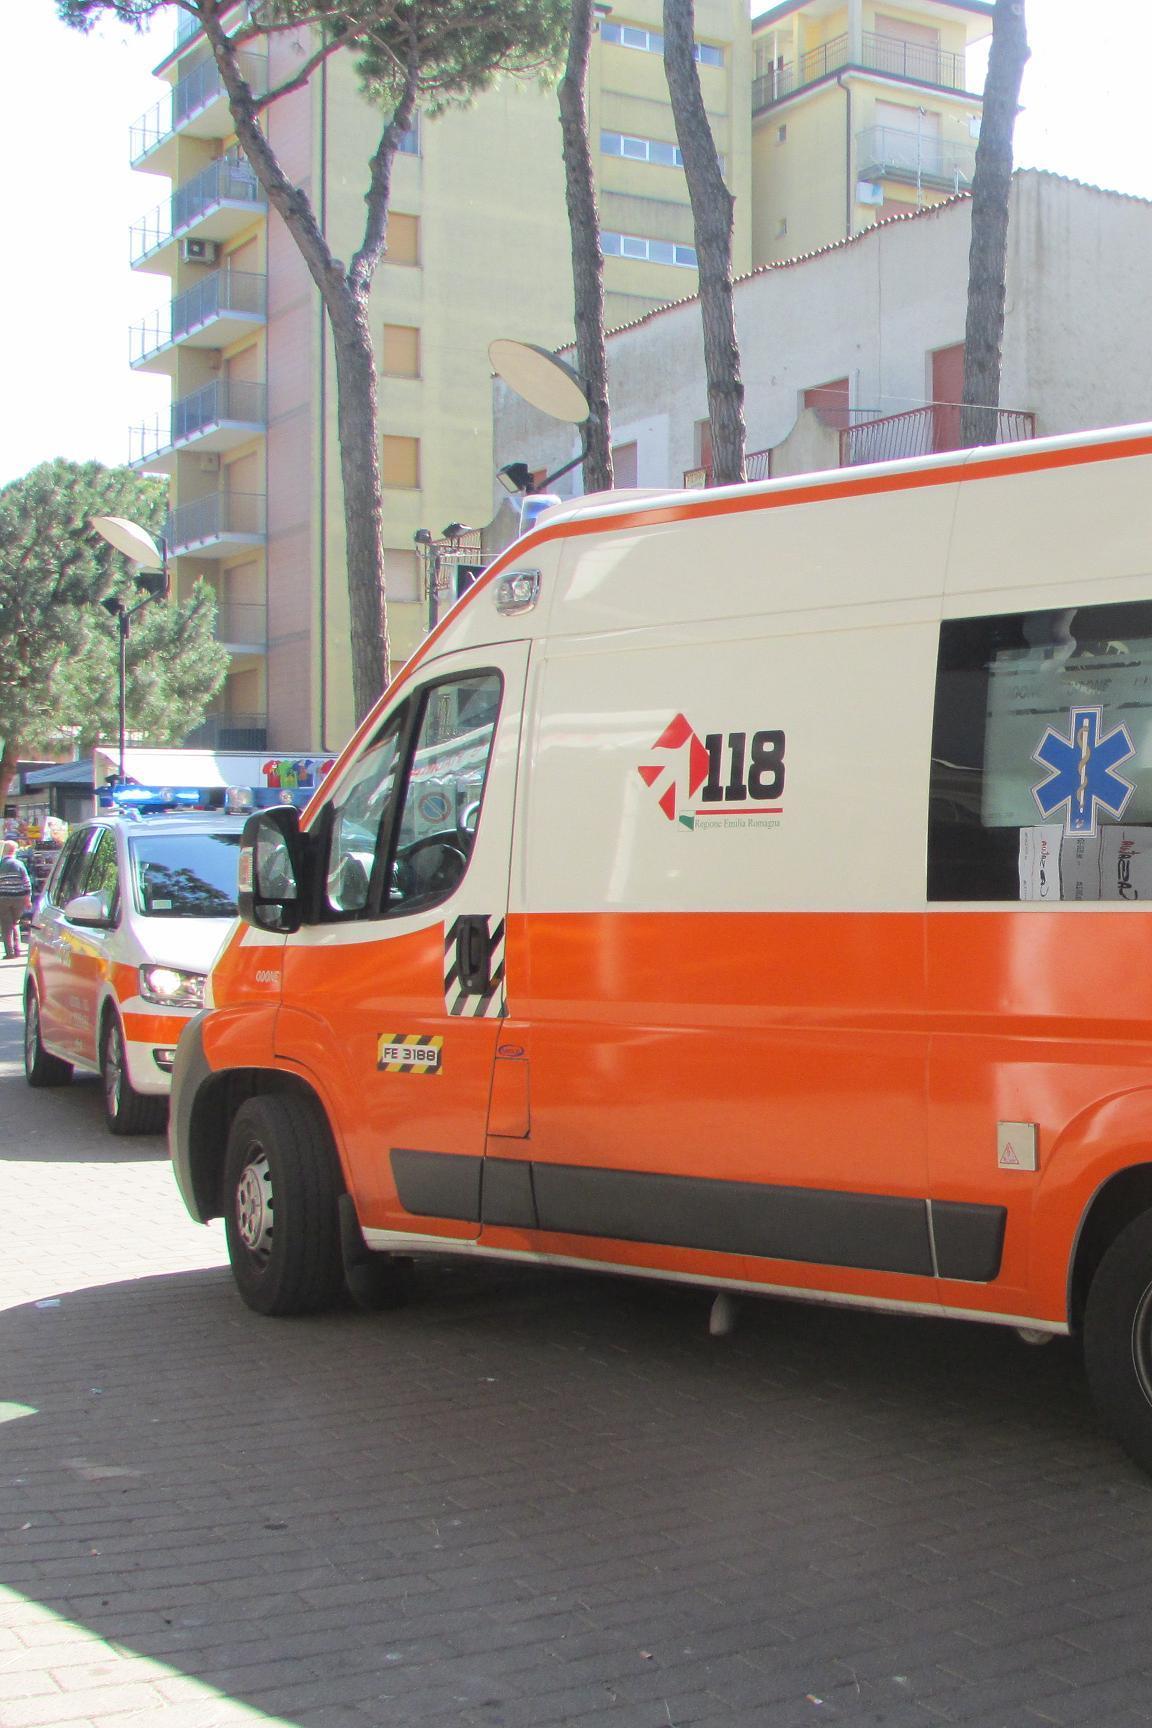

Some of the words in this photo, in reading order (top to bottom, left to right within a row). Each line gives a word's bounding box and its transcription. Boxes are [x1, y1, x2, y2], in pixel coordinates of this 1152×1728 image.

[702, 729, 786, 802] 118
[724, 817, 746, 828] Emilia
[383, 1047, 399, 1059] FE
[402, 1048, 436, 1061] 3188
